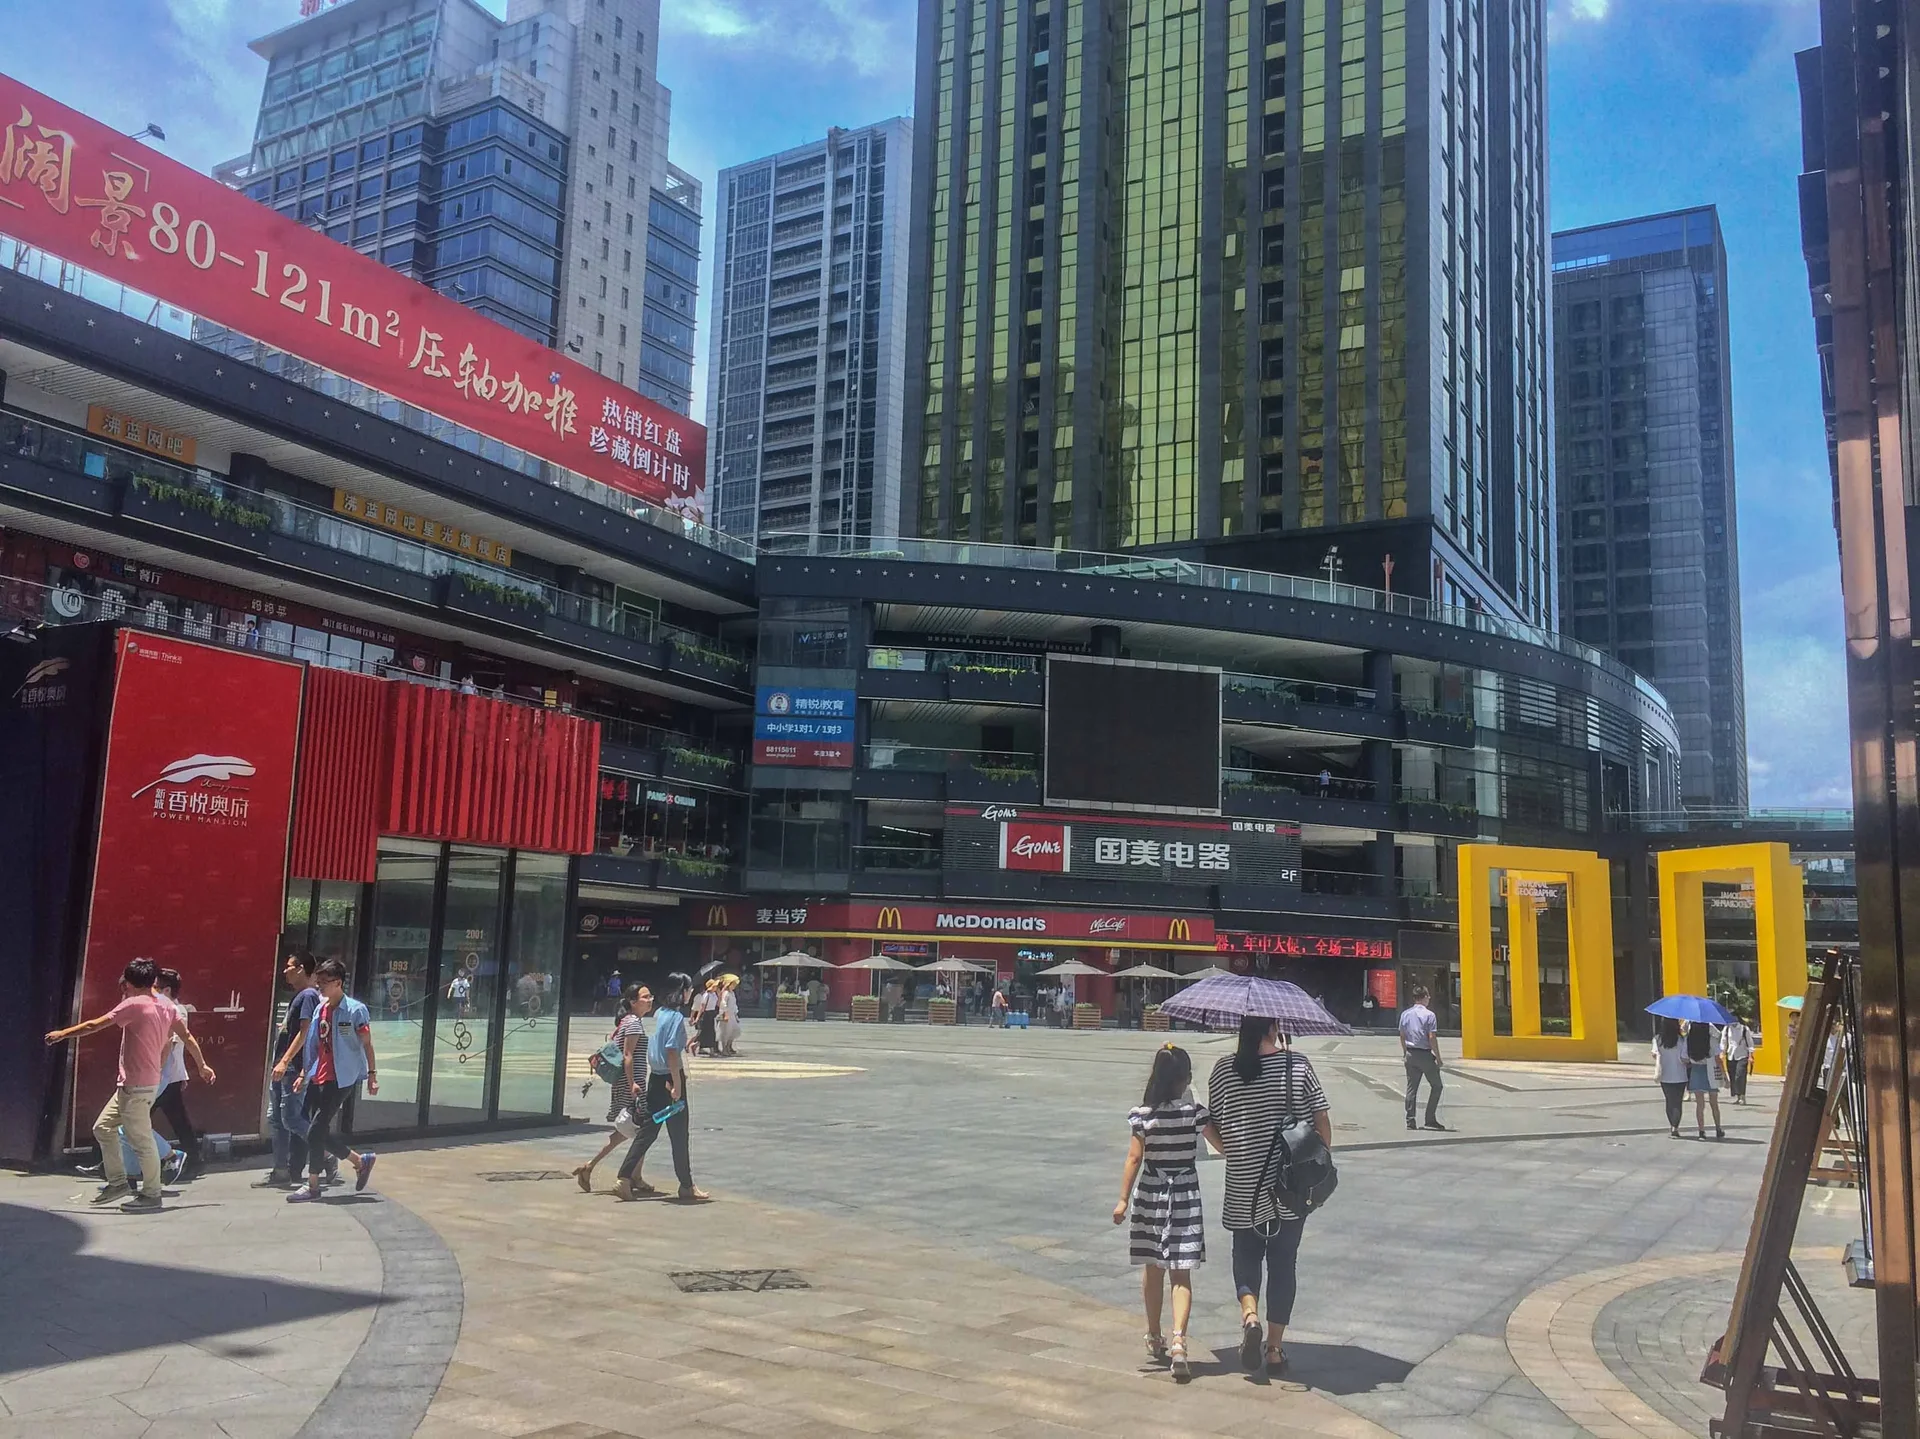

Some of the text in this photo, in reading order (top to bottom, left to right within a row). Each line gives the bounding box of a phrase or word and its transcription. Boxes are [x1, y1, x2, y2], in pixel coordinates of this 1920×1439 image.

[408, 325, 578, 441] 压轴加推
[103, 413, 184, 456] 沸蓝网吧
[601, 396, 682, 457] 热销红盘
[589, 425, 691, 491] 珍藏倒计时
[168, 791, 249, 818] 香悦奥府
[153, 811, 247, 827] POWER MANSION
[1232, 821, 1276, 833] 国美电器
[1094, 837, 1231, 870] 国美电器
[1281, 869, 1297, 882] 2F
[756, 908, 807, 925] 麦当劳
[936, 913, 1046, 931] McDonald's
